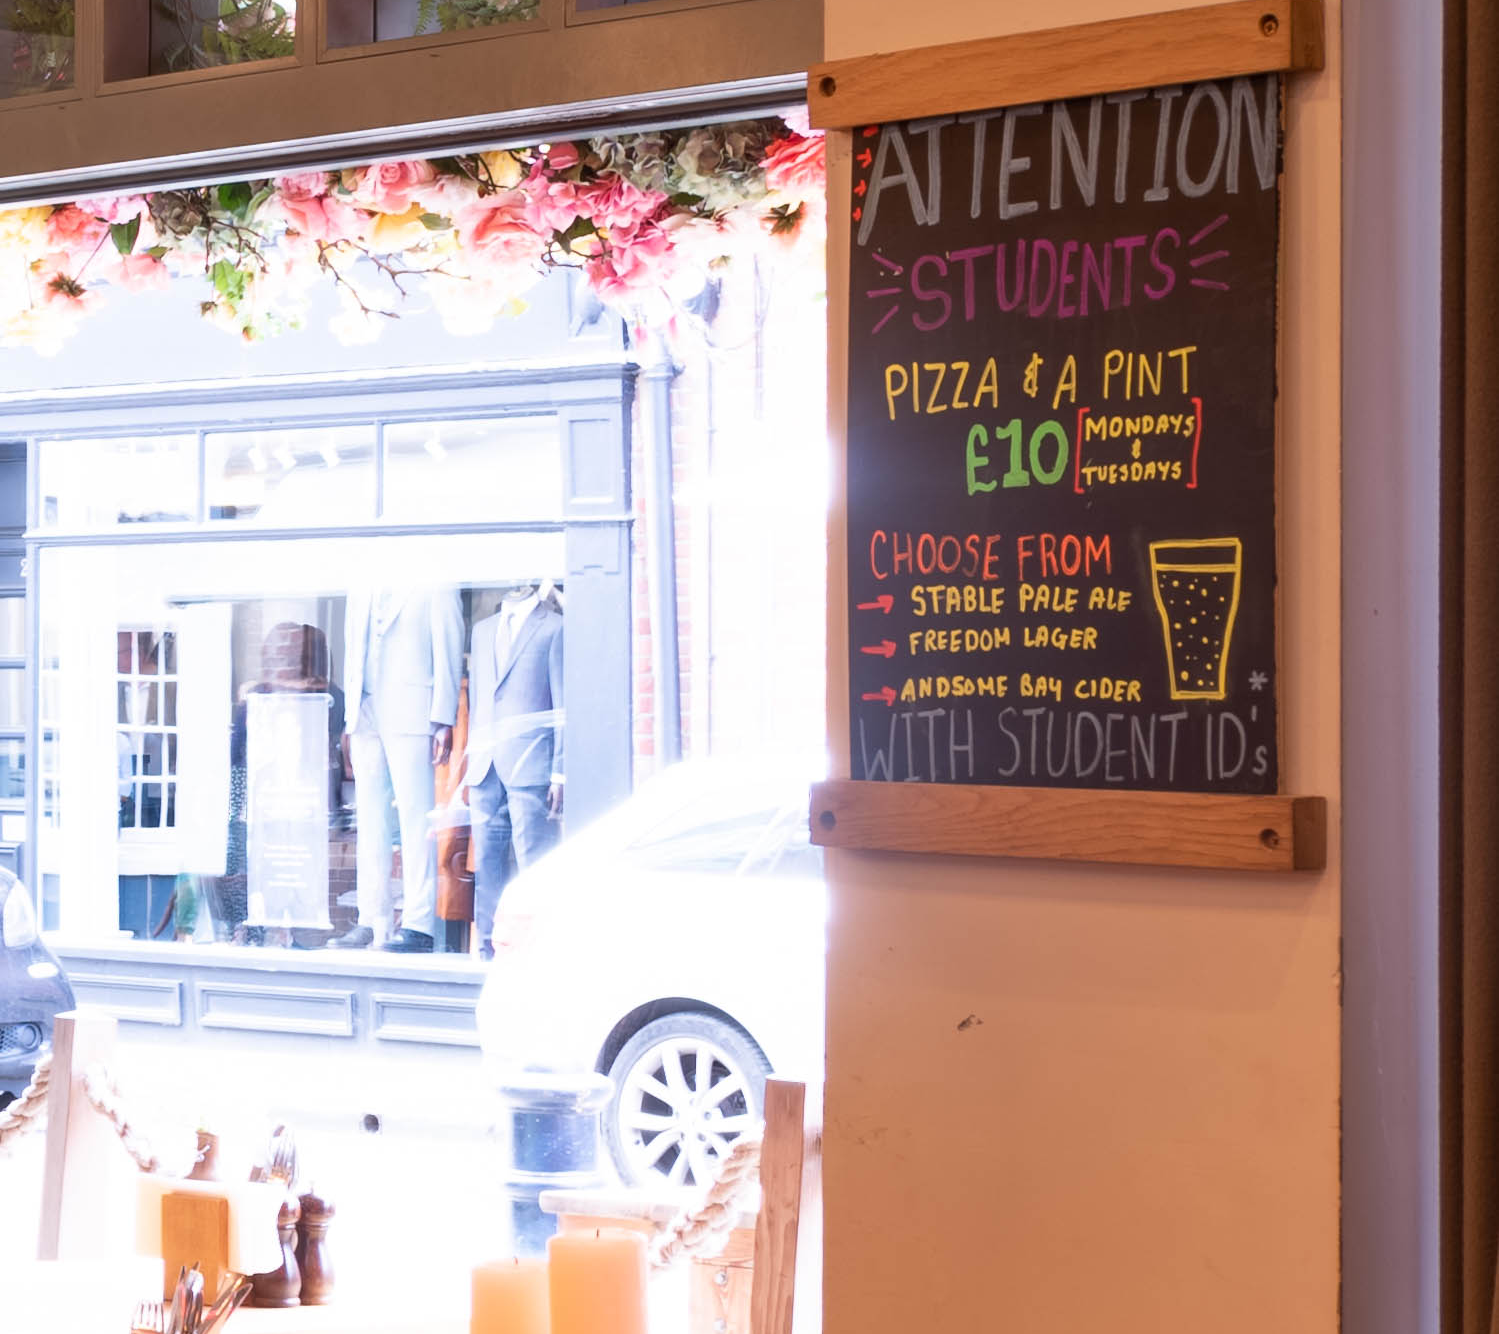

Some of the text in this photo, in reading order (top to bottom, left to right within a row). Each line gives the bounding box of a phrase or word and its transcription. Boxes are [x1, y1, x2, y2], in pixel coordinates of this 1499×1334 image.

[858, 74, 1277, 246] ATTENTION
[911, 227, 1181, 332] STUDENTS
[885, 357, 998, 420] PIZZA
[1052, 355, 1076, 409] A
[1104, 346, 1197, 400] PINT
[966, 419, 1069, 496] £10
[1082, 462, 1182, 486] TUESDAYS
[871, 530, 1112, 581] CHOOSE FROM
[912, 583, 1132, 616] STABLE PALE ALE
[909, 626, 1097, 655] FREEDOM LAGER
[901, 674, 1142, 703] ANDSOME BAY CIDER
[860, 708, 974, 782] WITH
[998, 707, 1189, 783] STUDENT
